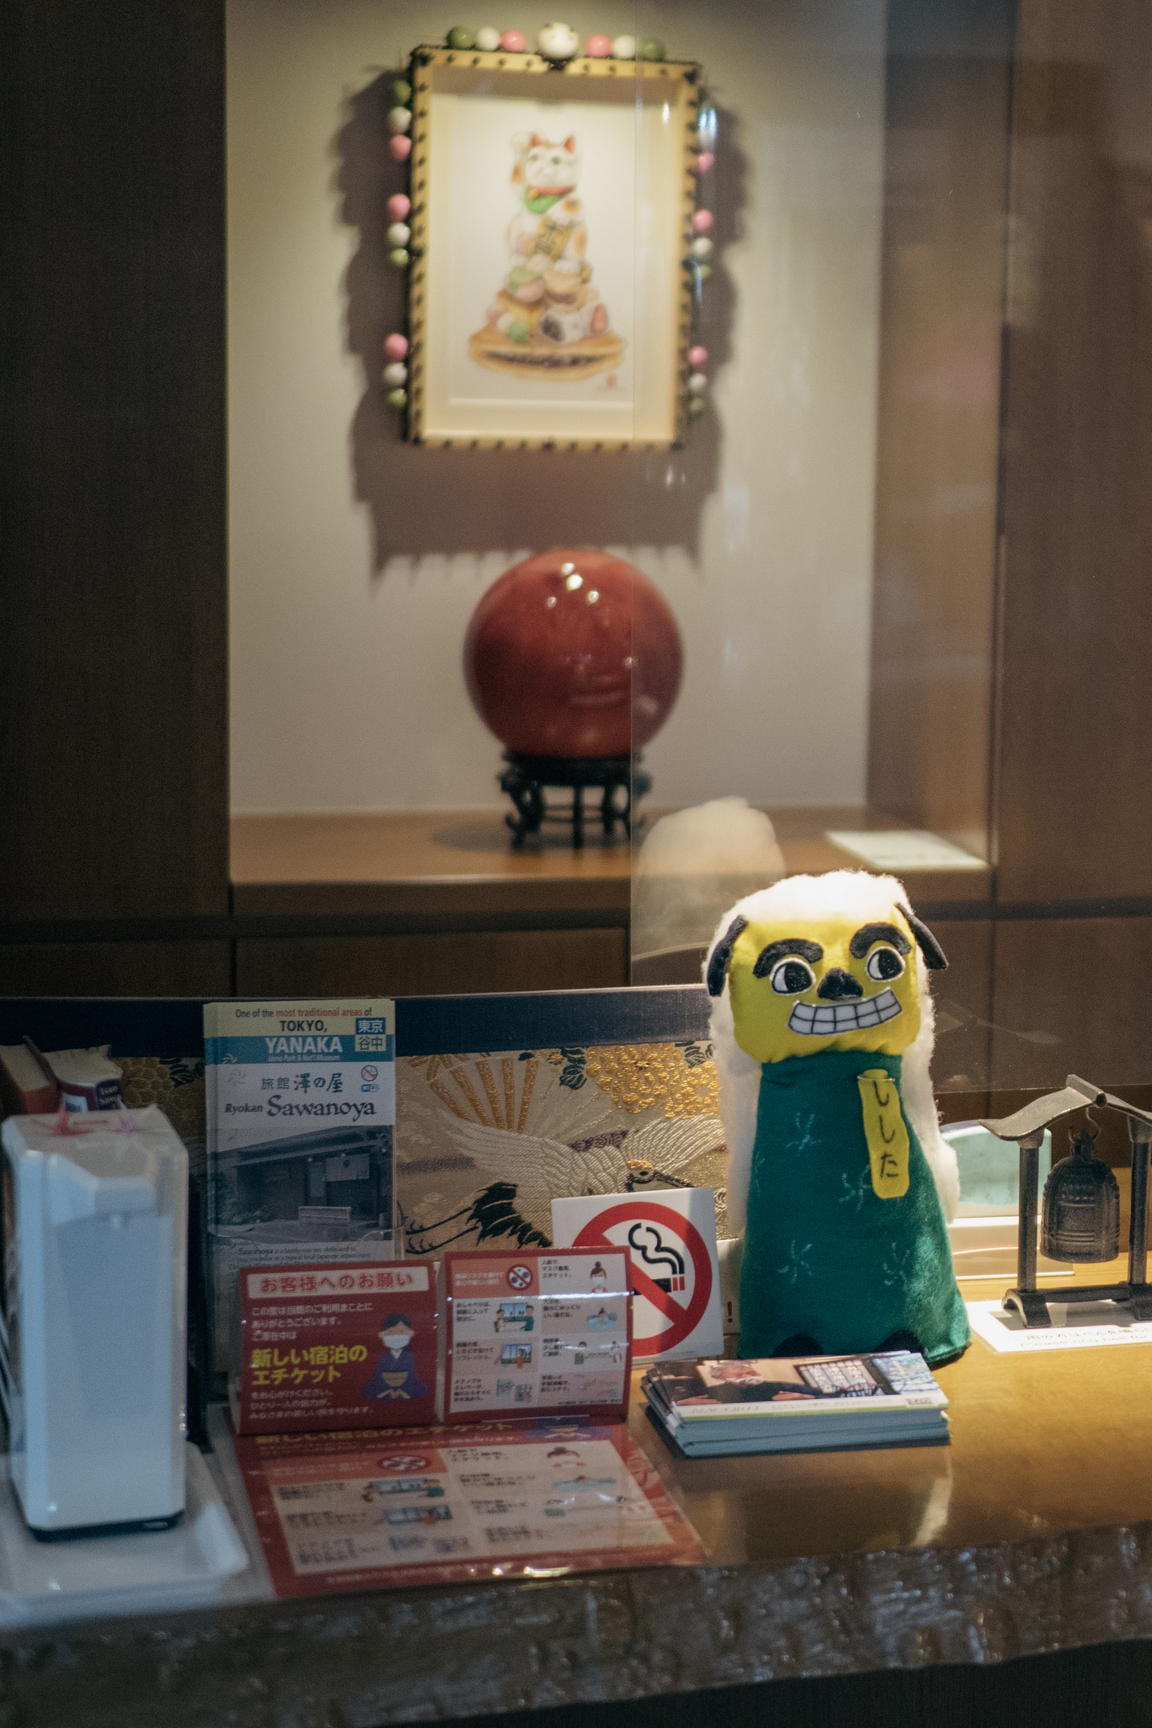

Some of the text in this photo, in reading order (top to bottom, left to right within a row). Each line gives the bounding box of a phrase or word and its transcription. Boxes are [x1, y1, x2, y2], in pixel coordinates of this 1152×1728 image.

[235, 1007, 372, 1018] One of the most traditional areas of
[279, 1020, 328, 1033] TOKYO,
[358, 1020, 384, 1033] 東京
[264, 1036, 344, 1053] YANAKA
[358, 1036, 384, 1050] 谷中
[262, 1073, 344, 1093] 旅館 澤の屋
[225, 1095, 377, 1122] Ryokan Sawanoya
[260, 1272, 413, 1293] お客様へのお願い
[252, 1316, 342, 1329] ありがとうございます。
[252, 1345, 368, 1368] 新しい宿泊の
[252, 1365, 342, 1385] エチケット
